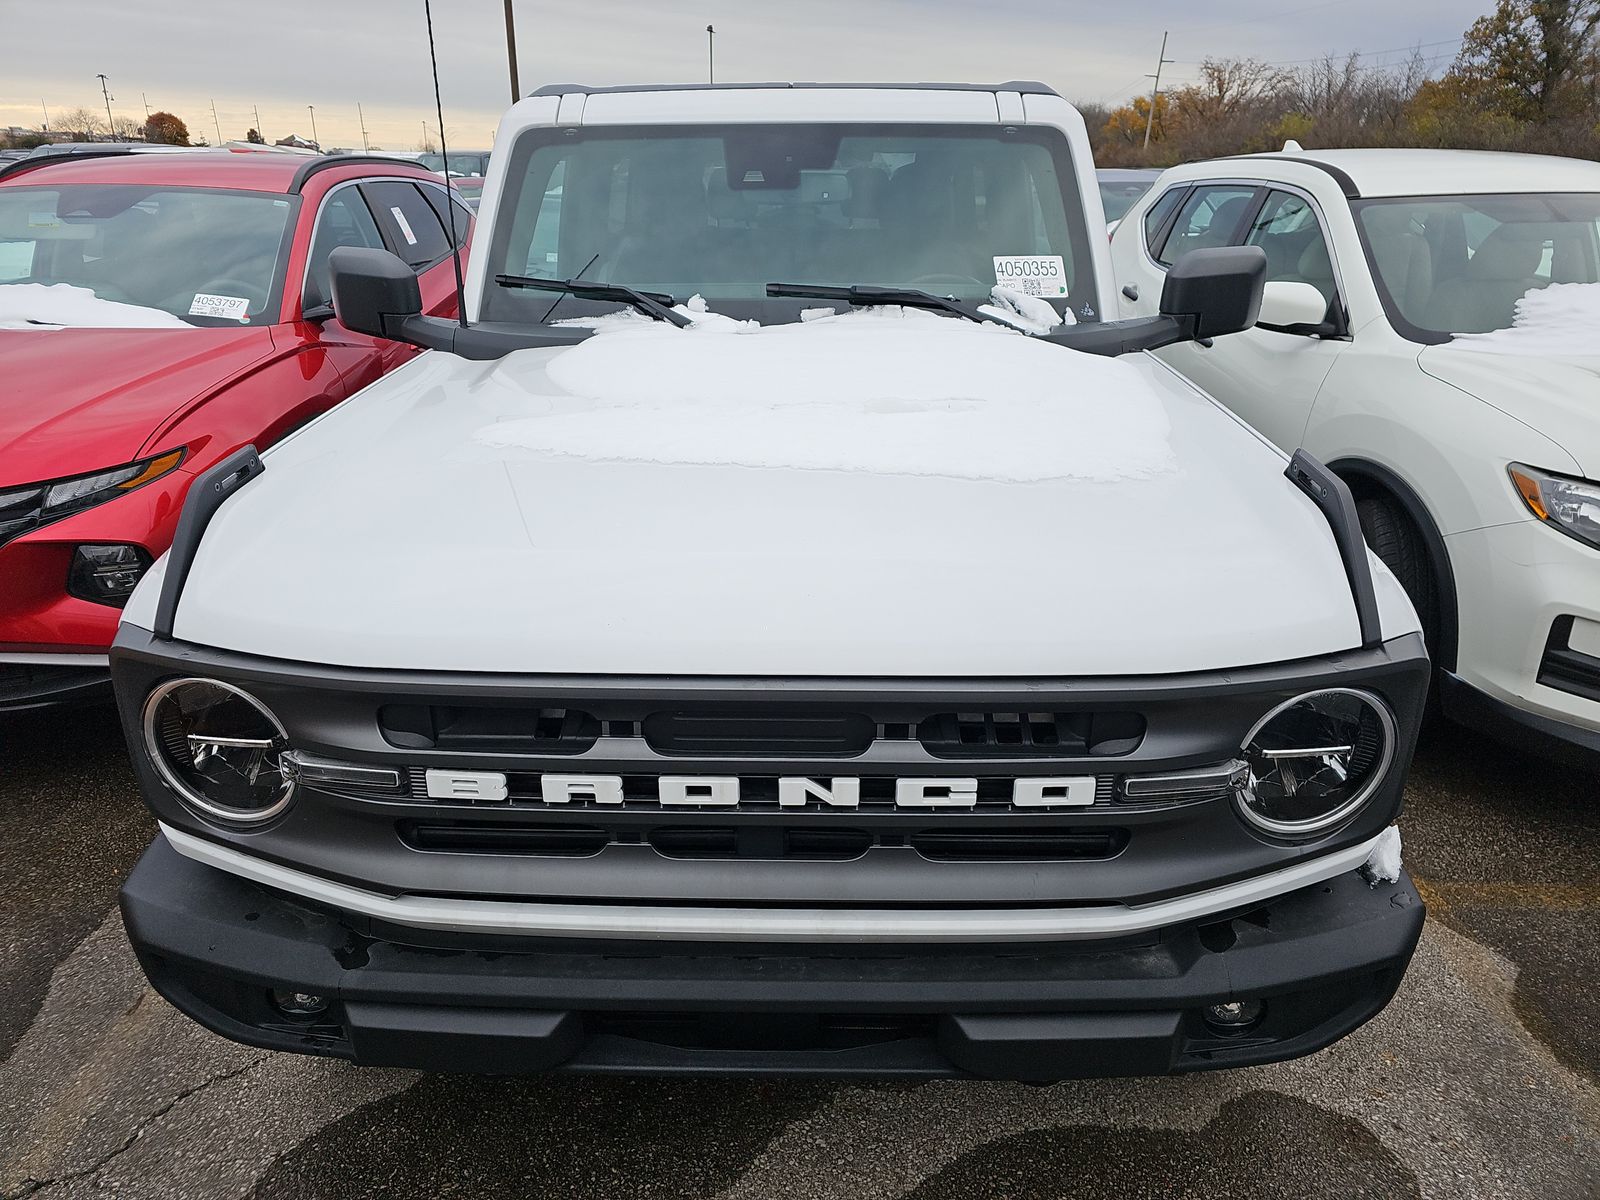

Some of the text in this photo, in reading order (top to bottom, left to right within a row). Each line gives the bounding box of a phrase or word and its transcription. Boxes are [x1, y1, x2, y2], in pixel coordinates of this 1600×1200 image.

[997, 261, 1057, 276] 4050355
[195, 296, 243, 308] 4053797
[425, 770, 1097, 807] BRONCO
